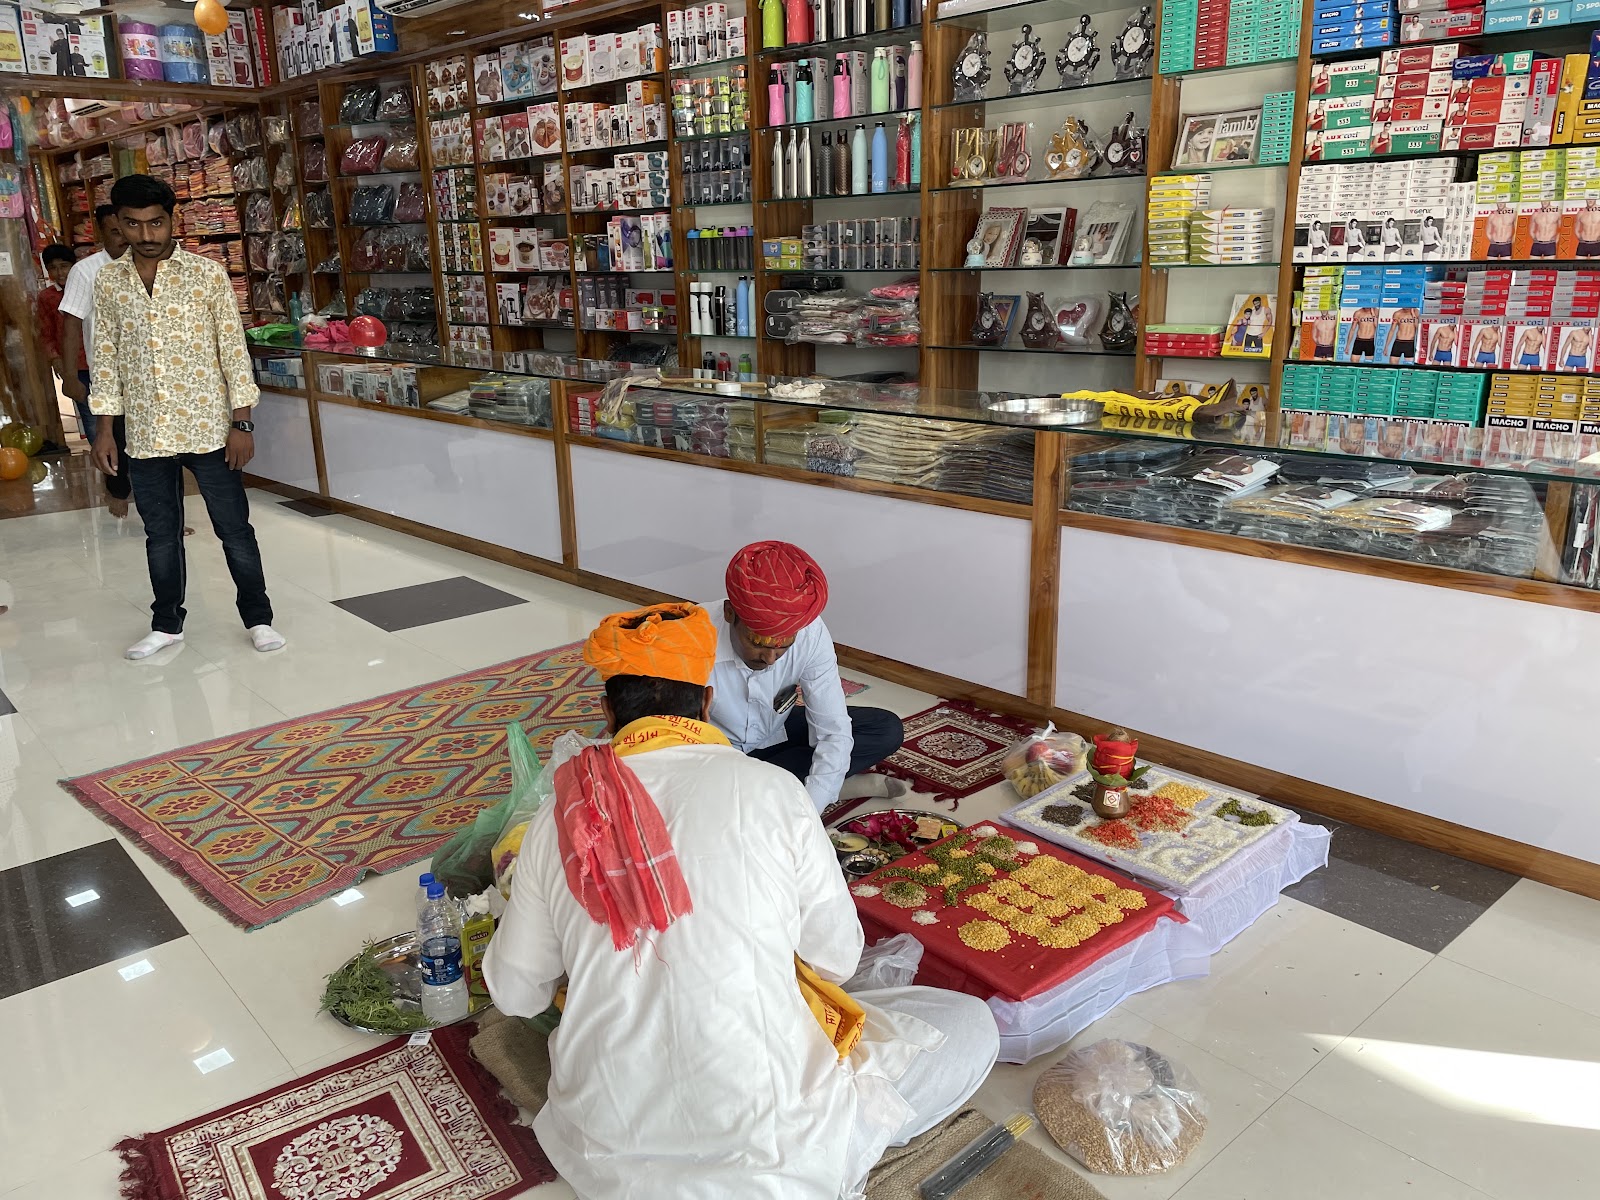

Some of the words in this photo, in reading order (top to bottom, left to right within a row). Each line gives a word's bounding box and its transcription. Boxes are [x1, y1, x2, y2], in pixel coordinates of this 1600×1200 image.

[1455, 59, 1491, 69] GenX
[1219, 116, 1256, 134] family
[1491, 418, 1524, 427] MACHO
[1535, 422, 1569, 431] MACHO
